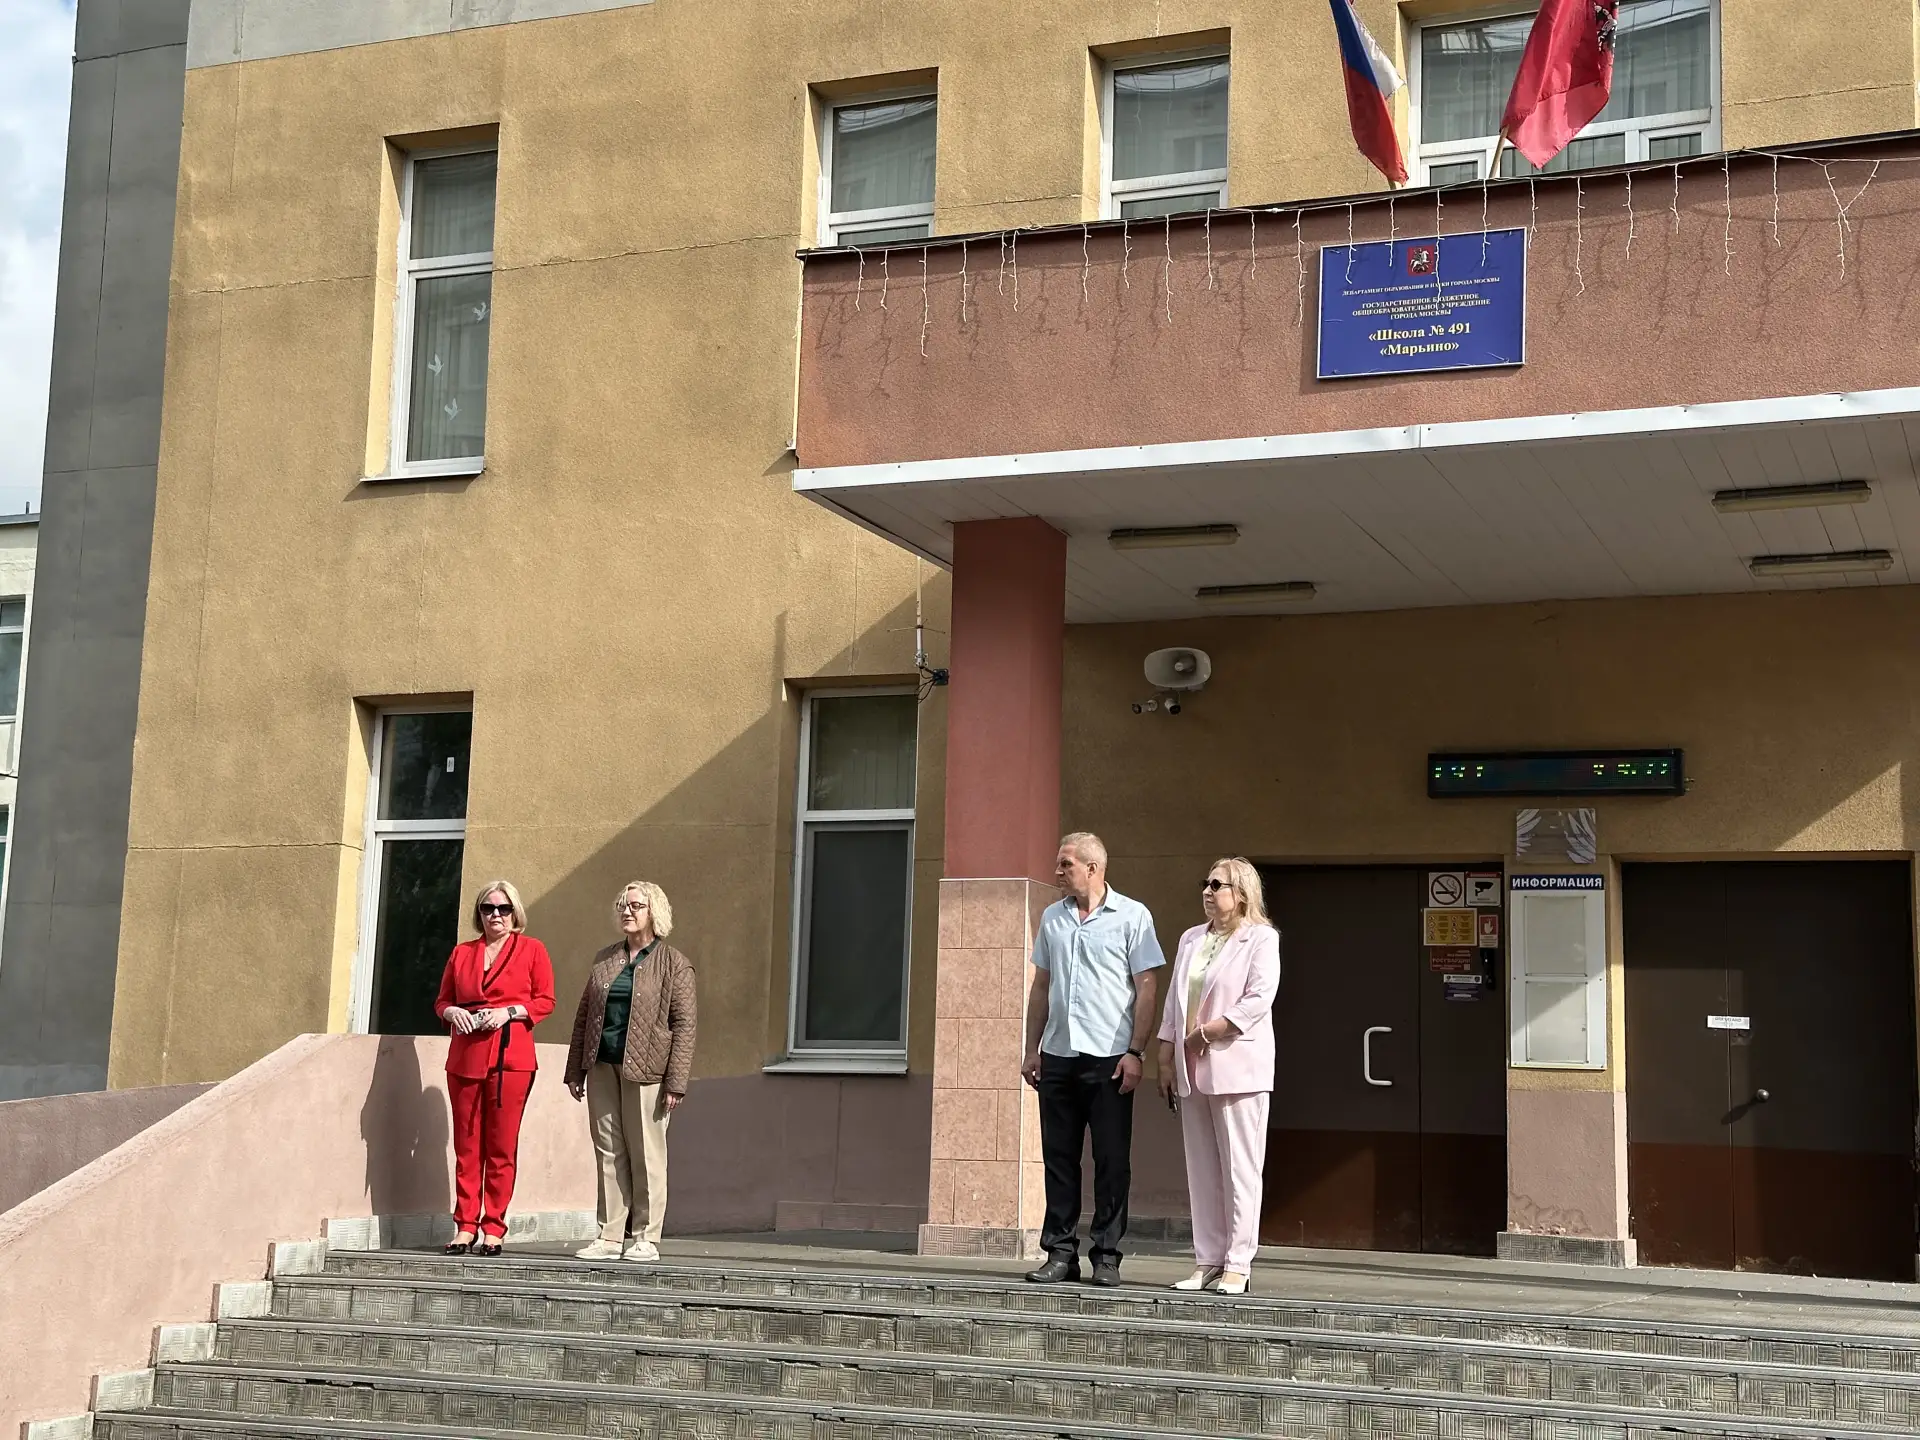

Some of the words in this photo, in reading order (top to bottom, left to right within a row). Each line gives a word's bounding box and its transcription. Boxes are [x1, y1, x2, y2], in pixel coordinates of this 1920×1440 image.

[1342, 287, 1383, 296] ДЕПАРТАМЕНТ
[1362, 297, 1431, 309] ГОСУДАРСТВЕННОЕ
[1433, 293, 1479, 303] БЮДЖЕТНОЕ
[1441, 298, 1491, 308] УЧРЕЖДЕНИЕ
[1419, 309, 1451, 317] МОСКВЫ
[1369, 327, 1425, 341] «Школа
[1429, 325, 1445, 337] №
[1448, 322, 1471, 334] 491
[1380, 342, 1460, 356] «Марьино»
[1512, 877, 1602, 888] ИНФОРМАЦИЯ
